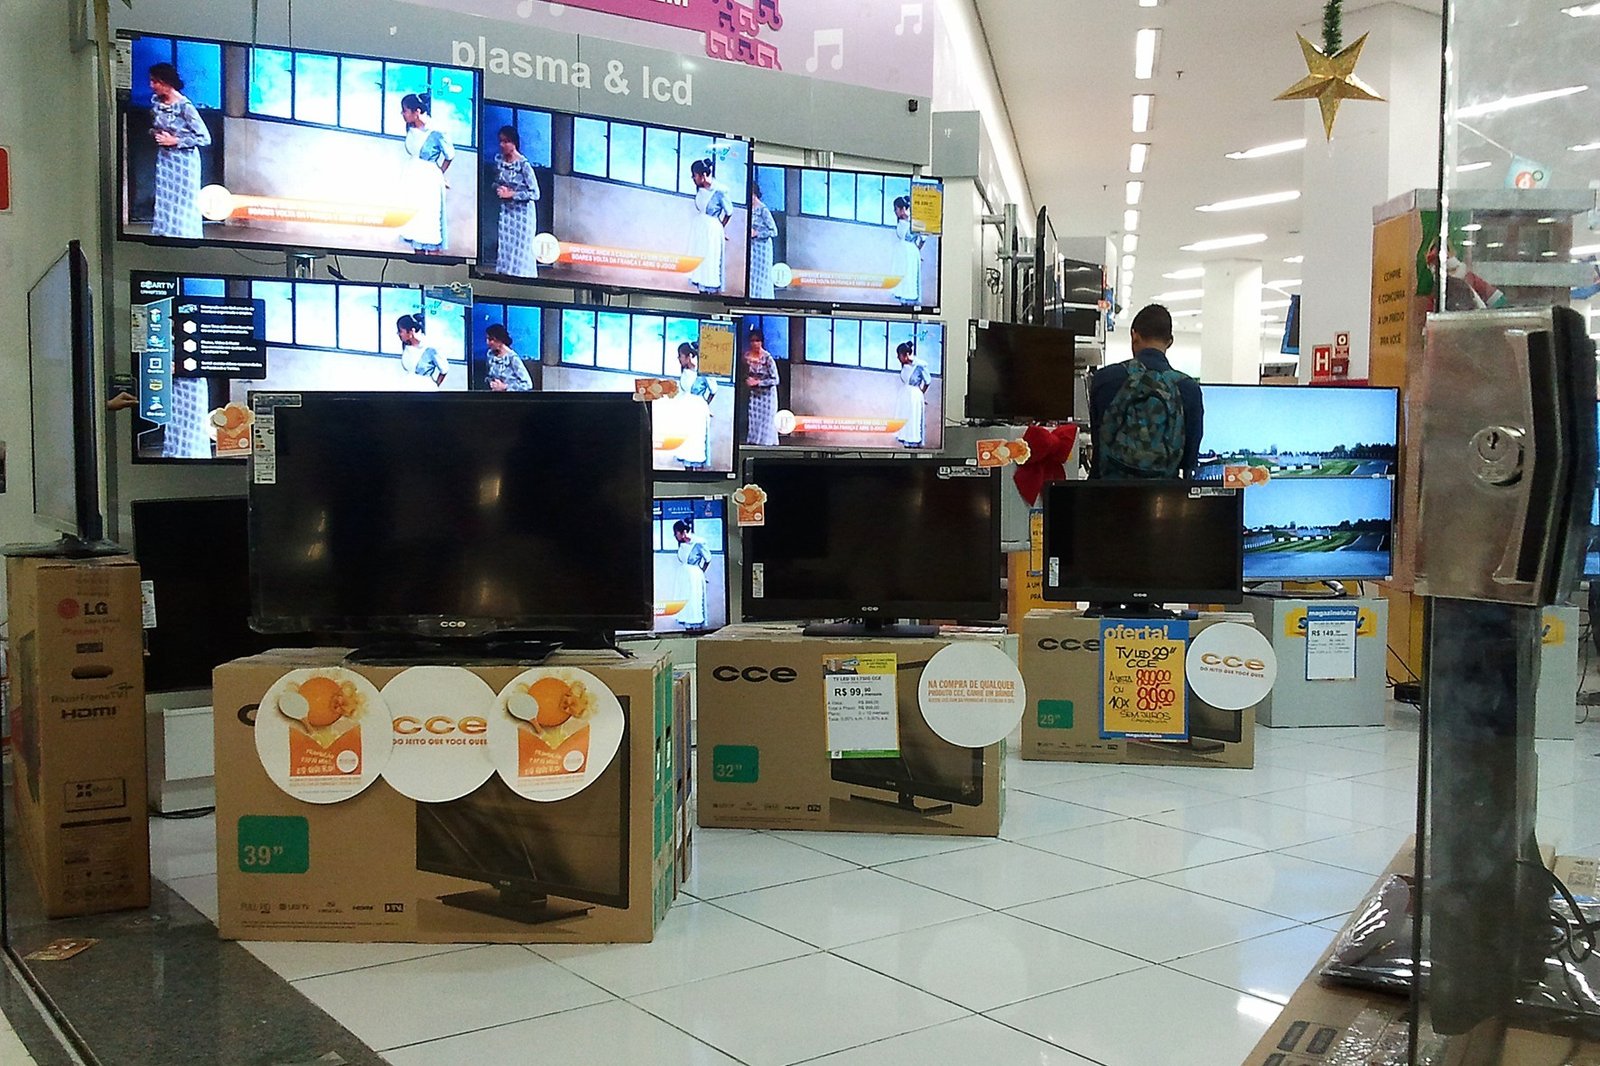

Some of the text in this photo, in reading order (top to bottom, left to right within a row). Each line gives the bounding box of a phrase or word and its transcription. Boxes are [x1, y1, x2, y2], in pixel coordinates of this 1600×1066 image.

[452, 36, 692, 106] plasma & lcd
[1316, 352, 1329, 371] H
[84, 602, 108, 616] LG
[1104, 624, 1168, 640] oferta!
[1038, 638, 1100, 652] cce
[1116, 647, 1134, 660] TV
[1134, 650, 1150, 659] LED
[1126, 659, 1158, 668] CCE
[1201, 653, 1265, 671] cce
[712, 665, 797, 683] cce
[928, 680, 1015, 689] NA COMPRA DE QUALQUER
[834, 688, 847, 697] R$
[61, 706, 117, 719] HDMI
[393, 716, 487, 734] cce
[446, 736, 466, 745] VOCÊ
